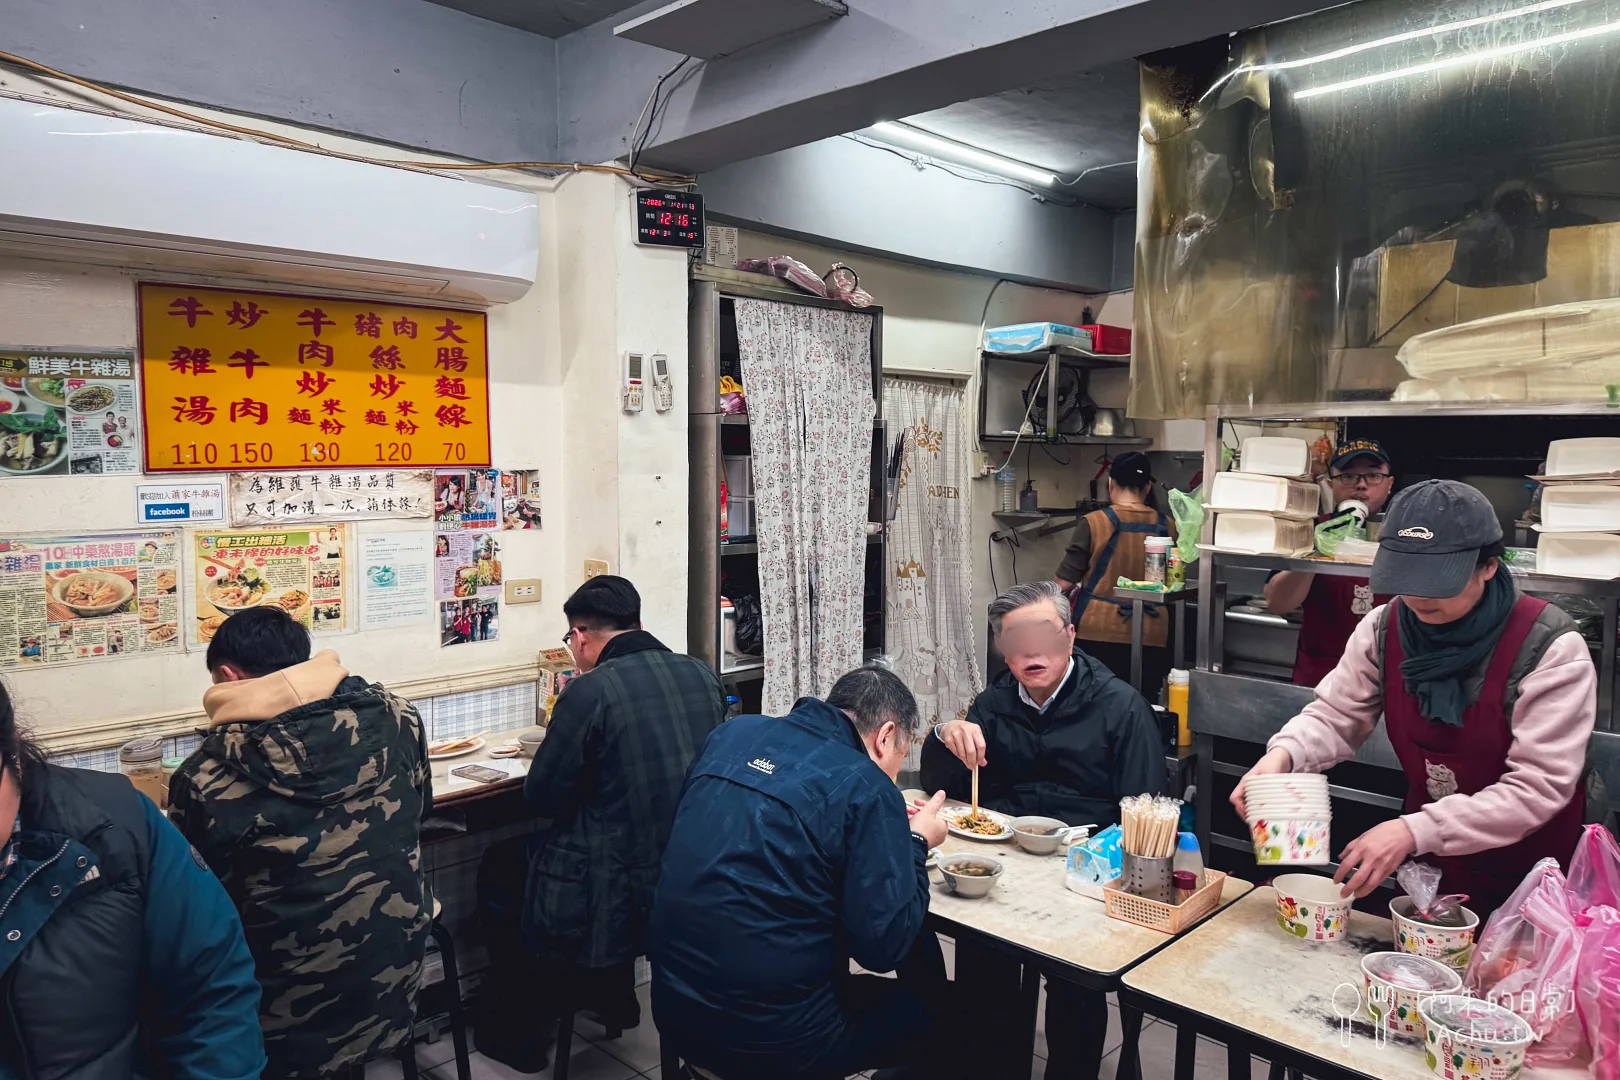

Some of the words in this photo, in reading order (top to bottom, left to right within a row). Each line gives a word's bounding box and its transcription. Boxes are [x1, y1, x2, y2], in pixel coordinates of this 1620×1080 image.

[28, 356, 131, 377] 鮮美牛雜湯
[433, 318, 473, 428] 大腸麵線
[171, 443, 218, 464] 110
[229, 442, 273, 463] 150
[300, 442, 340, 462] 130
[375, 442, 412, 462] 120
[442, 442, 466, 461] 70
[150, 507, 185, 516] facebook
[216, 535, 287, 548] 慢工出細活
